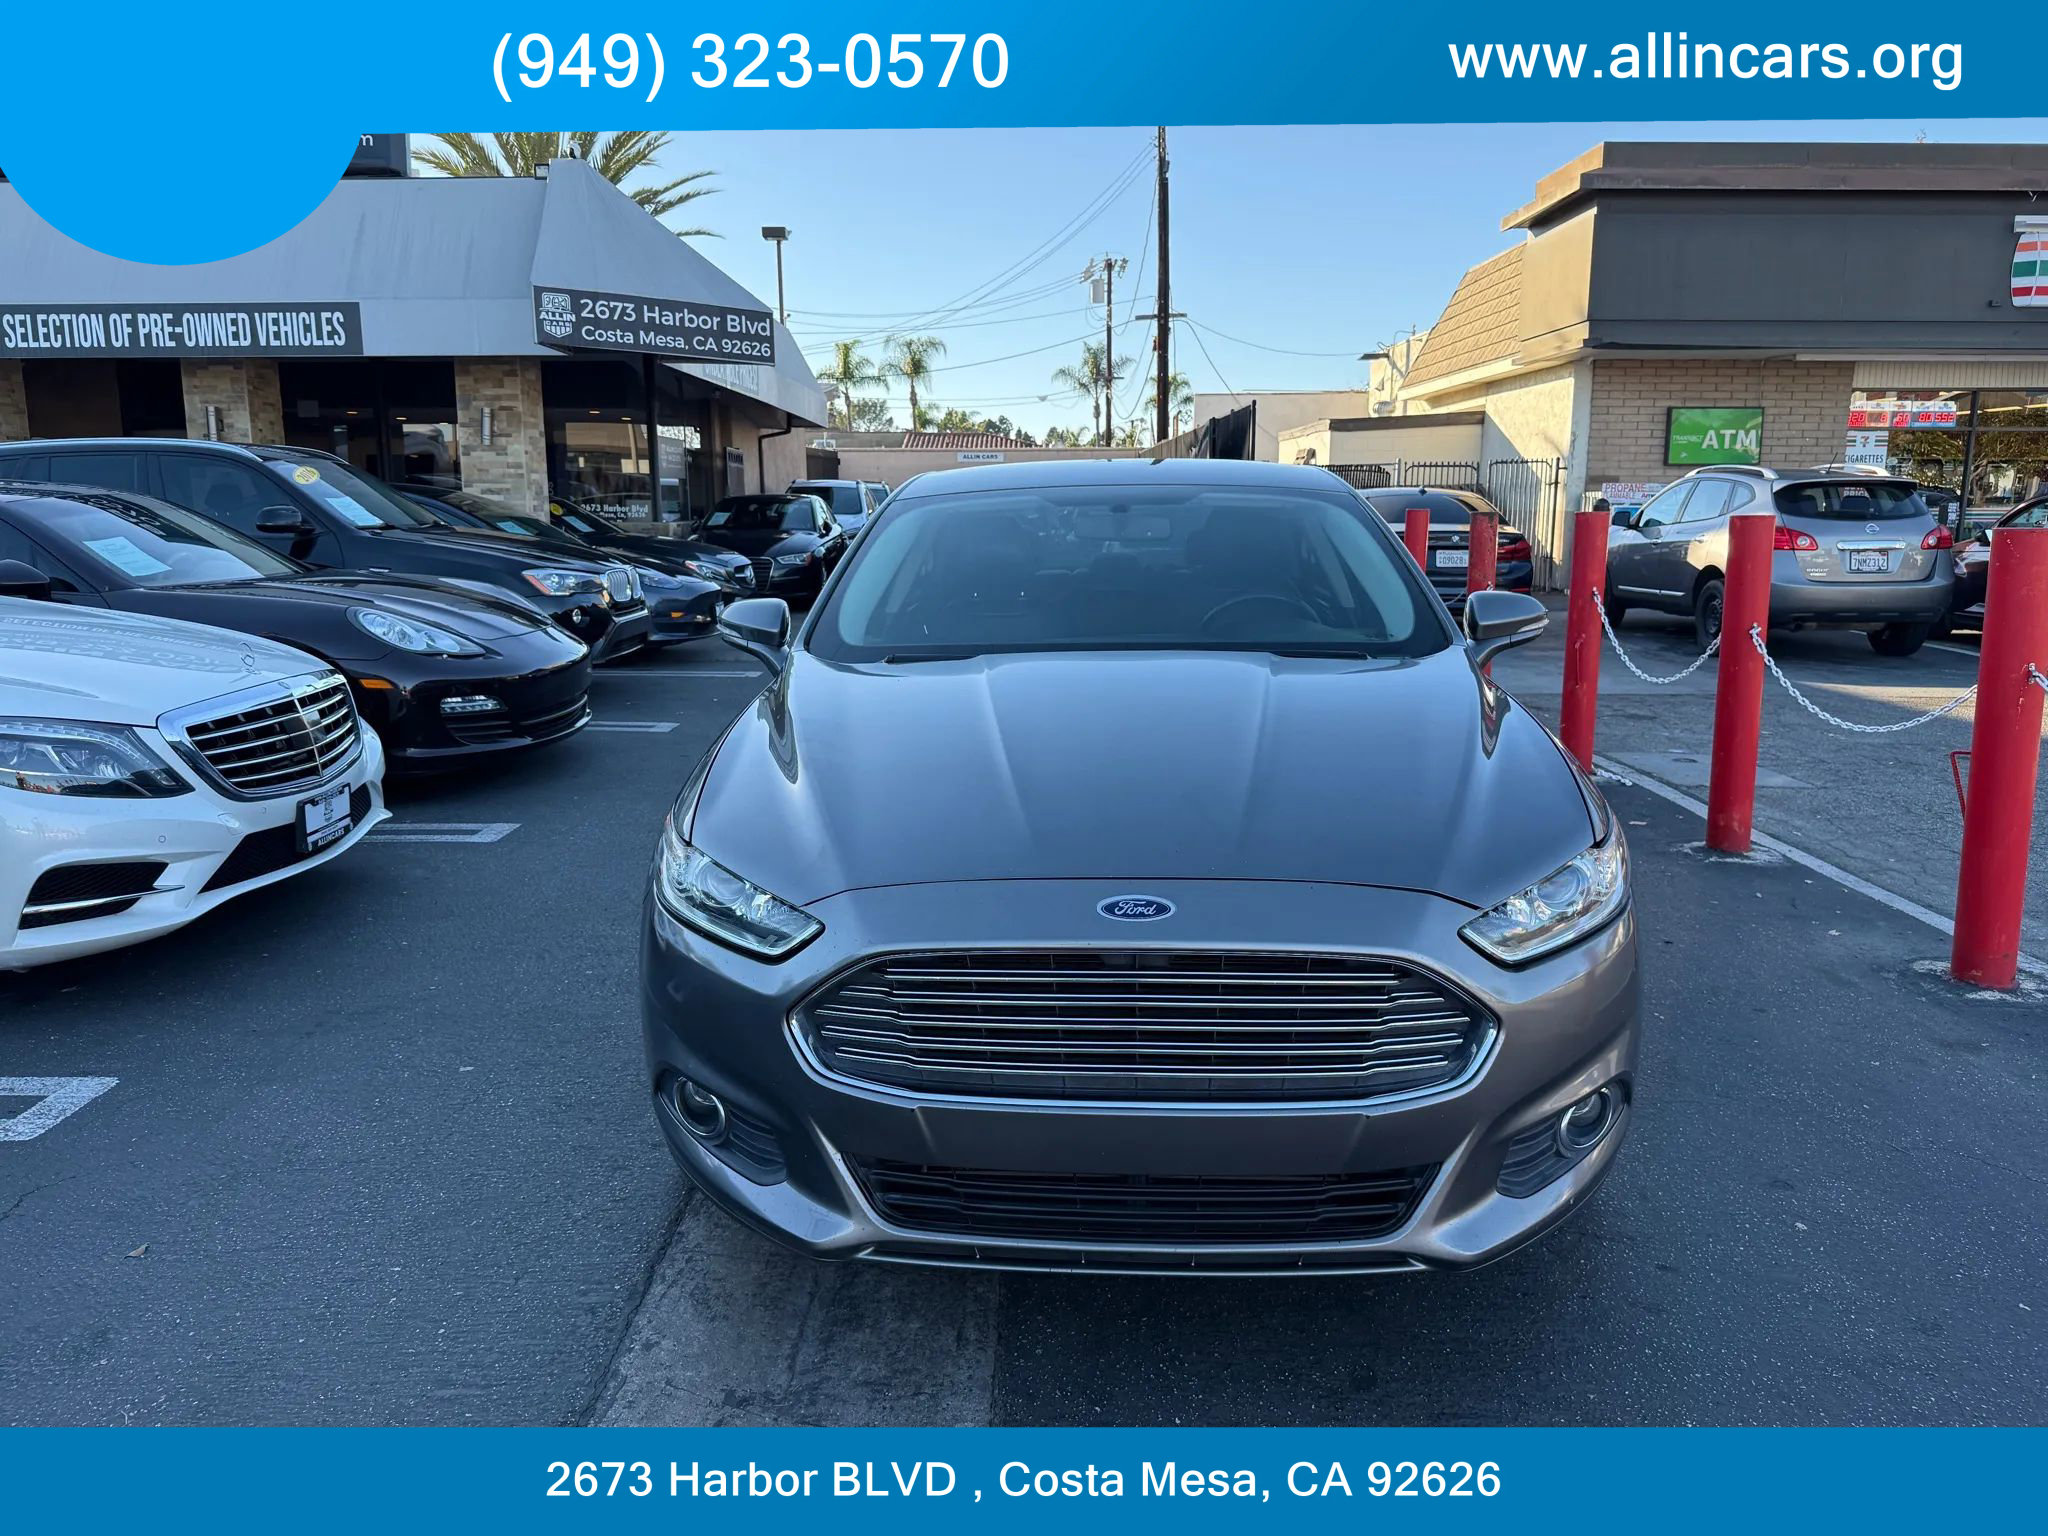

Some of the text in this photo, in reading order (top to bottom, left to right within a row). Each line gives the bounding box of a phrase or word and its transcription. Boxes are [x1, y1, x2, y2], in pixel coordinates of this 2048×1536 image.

[540, 311, 576, 322] ALLIN
[580, 299, 770, 337] 2673 Harbor Blvd
[2, 311, 346, 348] SELECTION OF PRE-OWNED VEHICLES
[581, 326, 771, 357] Costa Mesa, CA 92626
[1701, 429, 1758, 450] ATM
[1845, 454, 1884, 463] CIGARETTES
[1605, 483, 1648, 492] PROPANE
[603, 503, 630, 512] Harbor
[631, 504, 649, 513] Blvd
[1852, 557, 1887, 568] 7NMZ312
[1114, 900, 1157, 915] Ford
